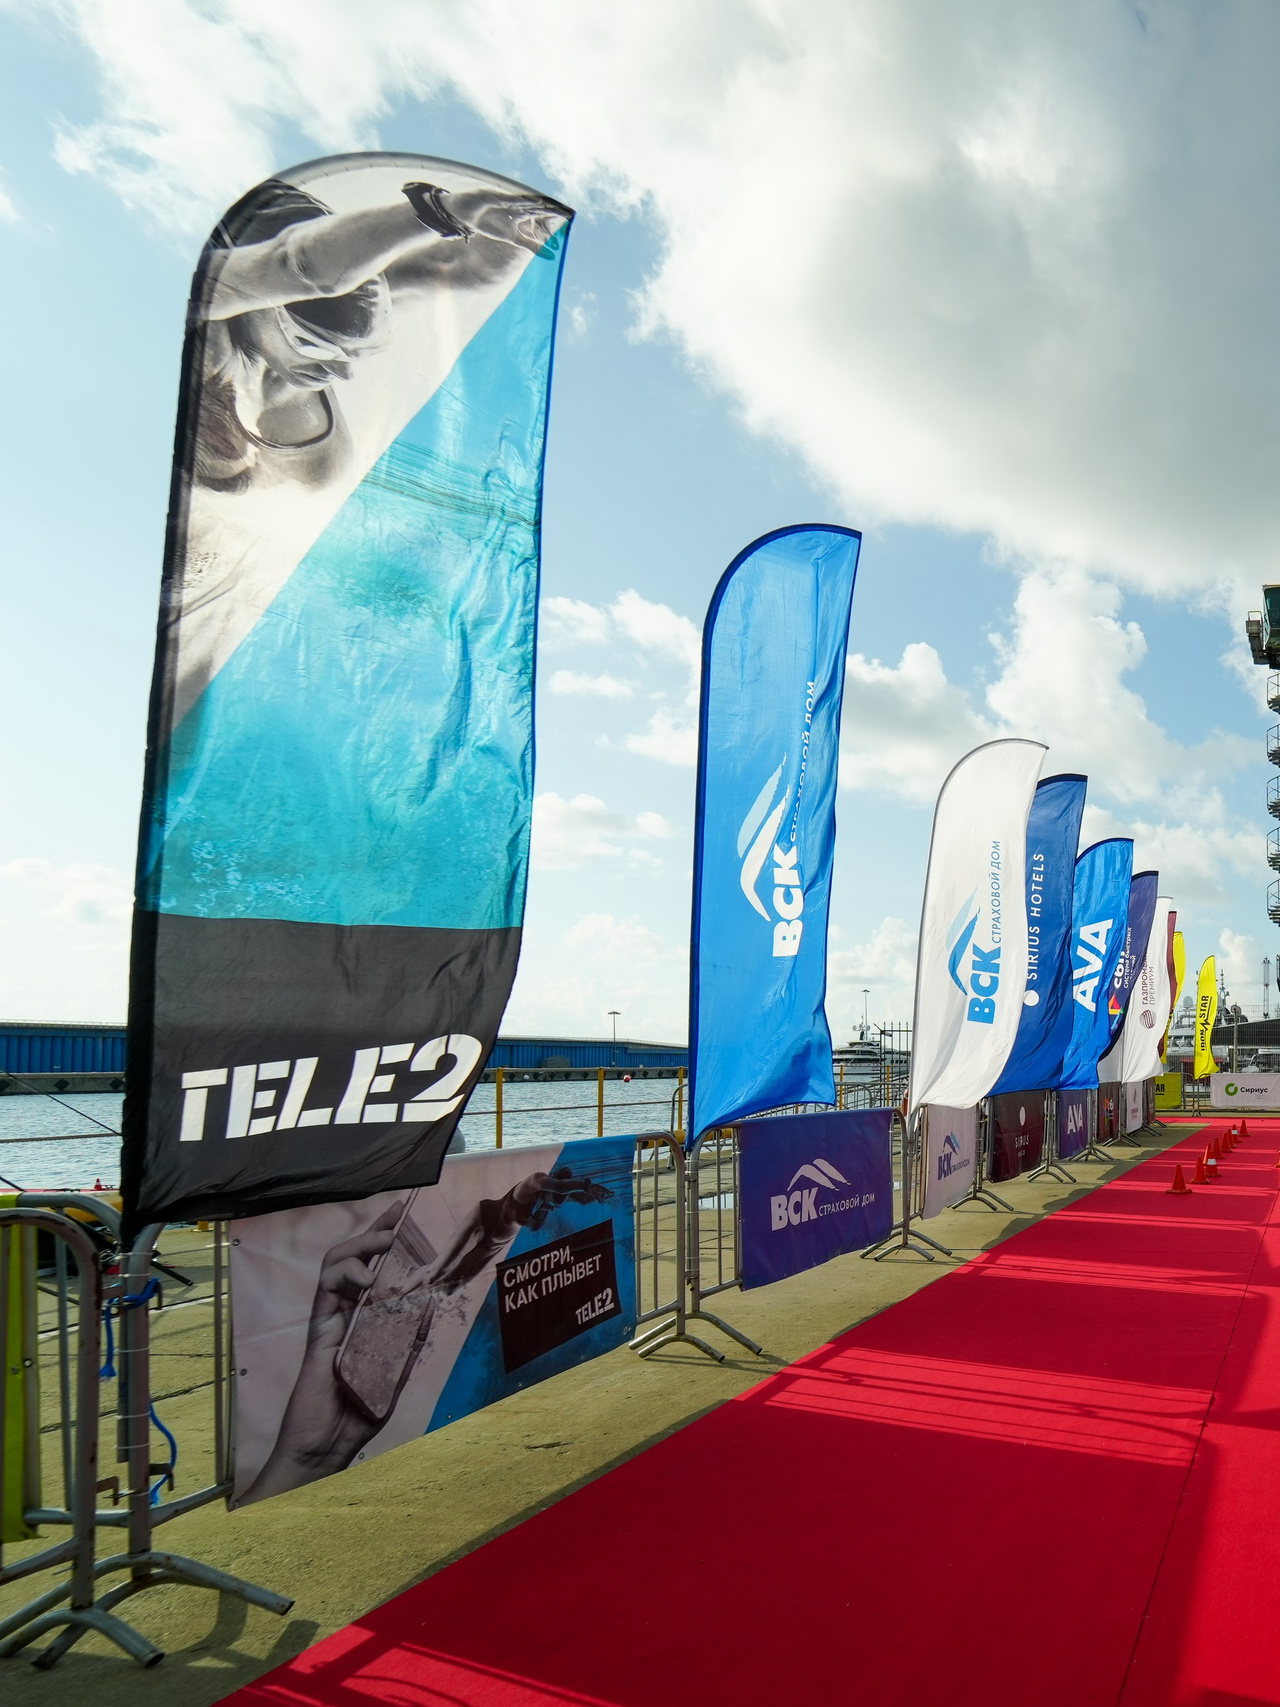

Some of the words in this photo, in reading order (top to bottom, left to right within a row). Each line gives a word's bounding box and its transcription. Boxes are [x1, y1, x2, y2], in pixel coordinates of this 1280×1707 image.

[772, 842, 804, 958] ВСК
[805, 681, 815, 726] ДОМ
[990, 840, 1001, 871] ДОМ
[988, 872, 1002, 944] СТРАХОВОЙ
[1030, 853, 1045, 917] HOTELS
[1027, 926, 1040, 980] SIRIUS
[1073, 918, 1113, 1012] AVA
[967, 943, 1002, 1025] ВСК
[1199, 995, 1209, 1019] STAR
[179, 1033, 483, 1142] TELE2
[1240, 1086, 1269, 1095] Сириус
[1067, 1103, 1084, 1135] AVA
[771, 1186, 819, 1232] ВСК
[818, 1194, 860, 1218] СТРАХОВОЙ
[861, 1193, 876, 1208] ДОМ
[503, 1245, 575, 1288] СМОТРИ,
[505, 1282, 540, 1314] КАК
[541, 1253, 602, 1297] ПЛЫВЕТ
[575, 1287, 615, 1326] TELE2
[622, 1326, 632, 1336] 0+
